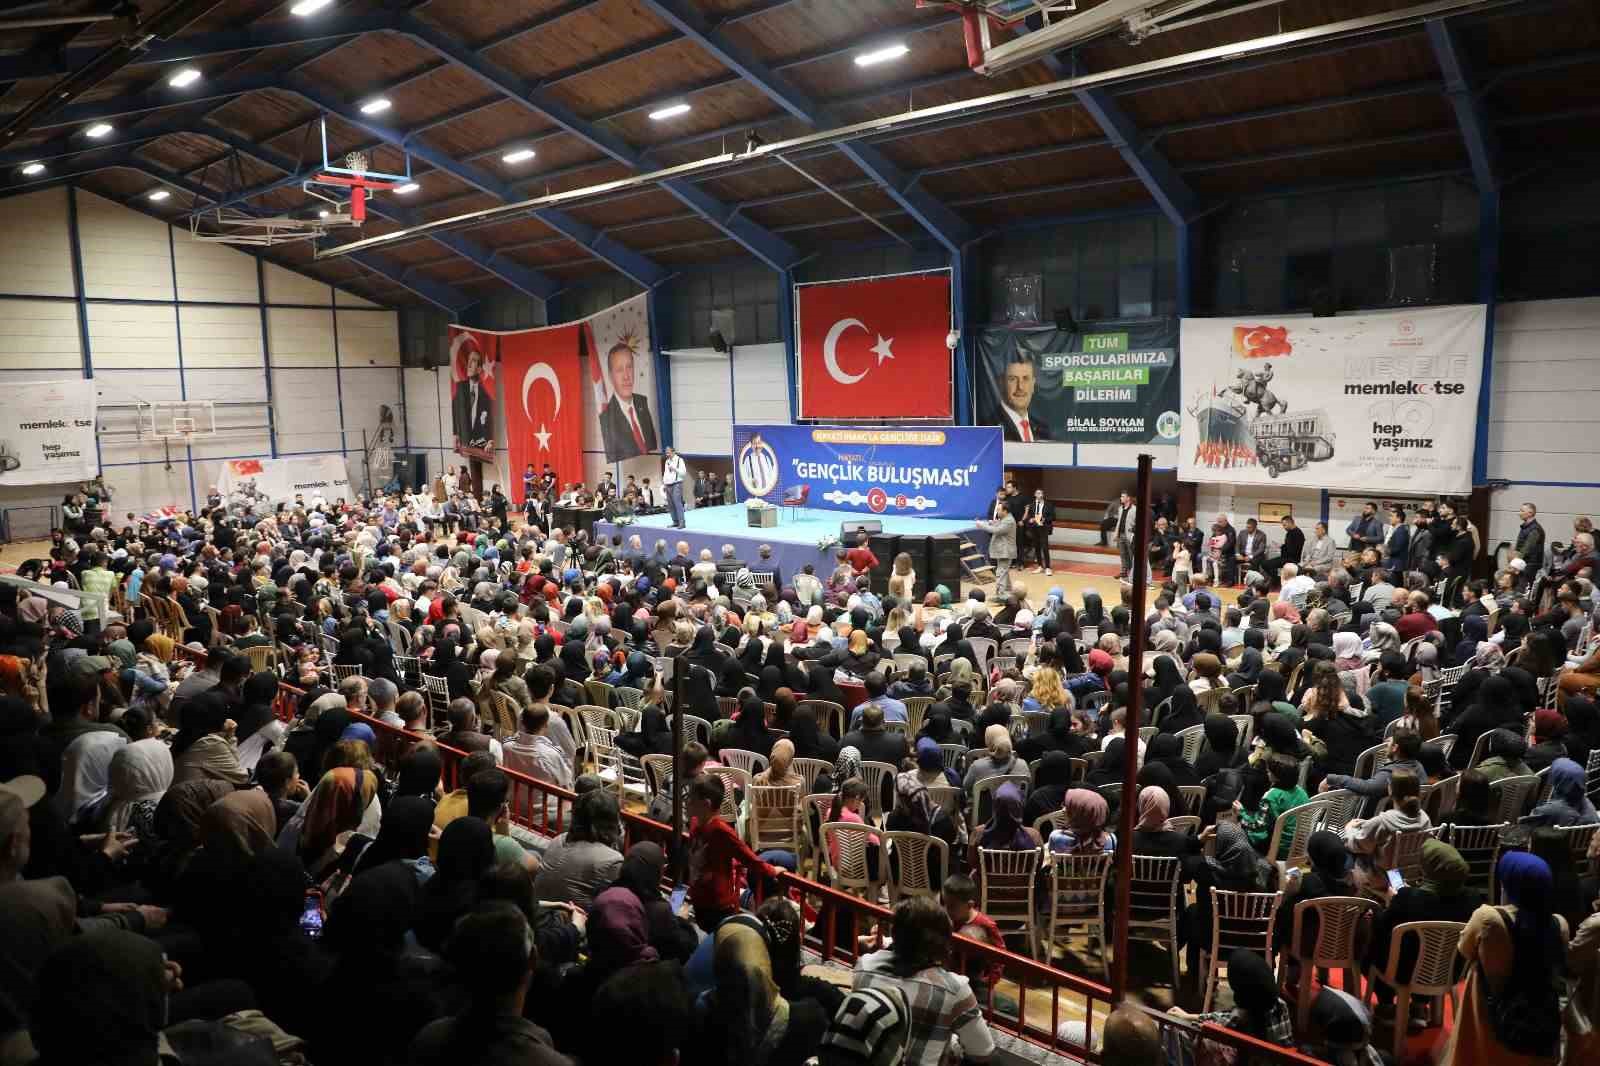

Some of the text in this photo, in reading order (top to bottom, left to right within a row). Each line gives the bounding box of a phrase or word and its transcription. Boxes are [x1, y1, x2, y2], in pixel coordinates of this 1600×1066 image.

[1088, 335, 1119, 349] TÜM
[1045, 351, 1167, 367] SPORCULARIMIZA
[1065, 368, 1143, 384] BAŞARILAR
[1076, 386, 1131, 400] DİLERİM
[1067, 416, 1144, 427] BİLAL SOYKAN
[1373, 422, 1402, 437] hep
[1373, 437, 1433, 451] yaşımız
